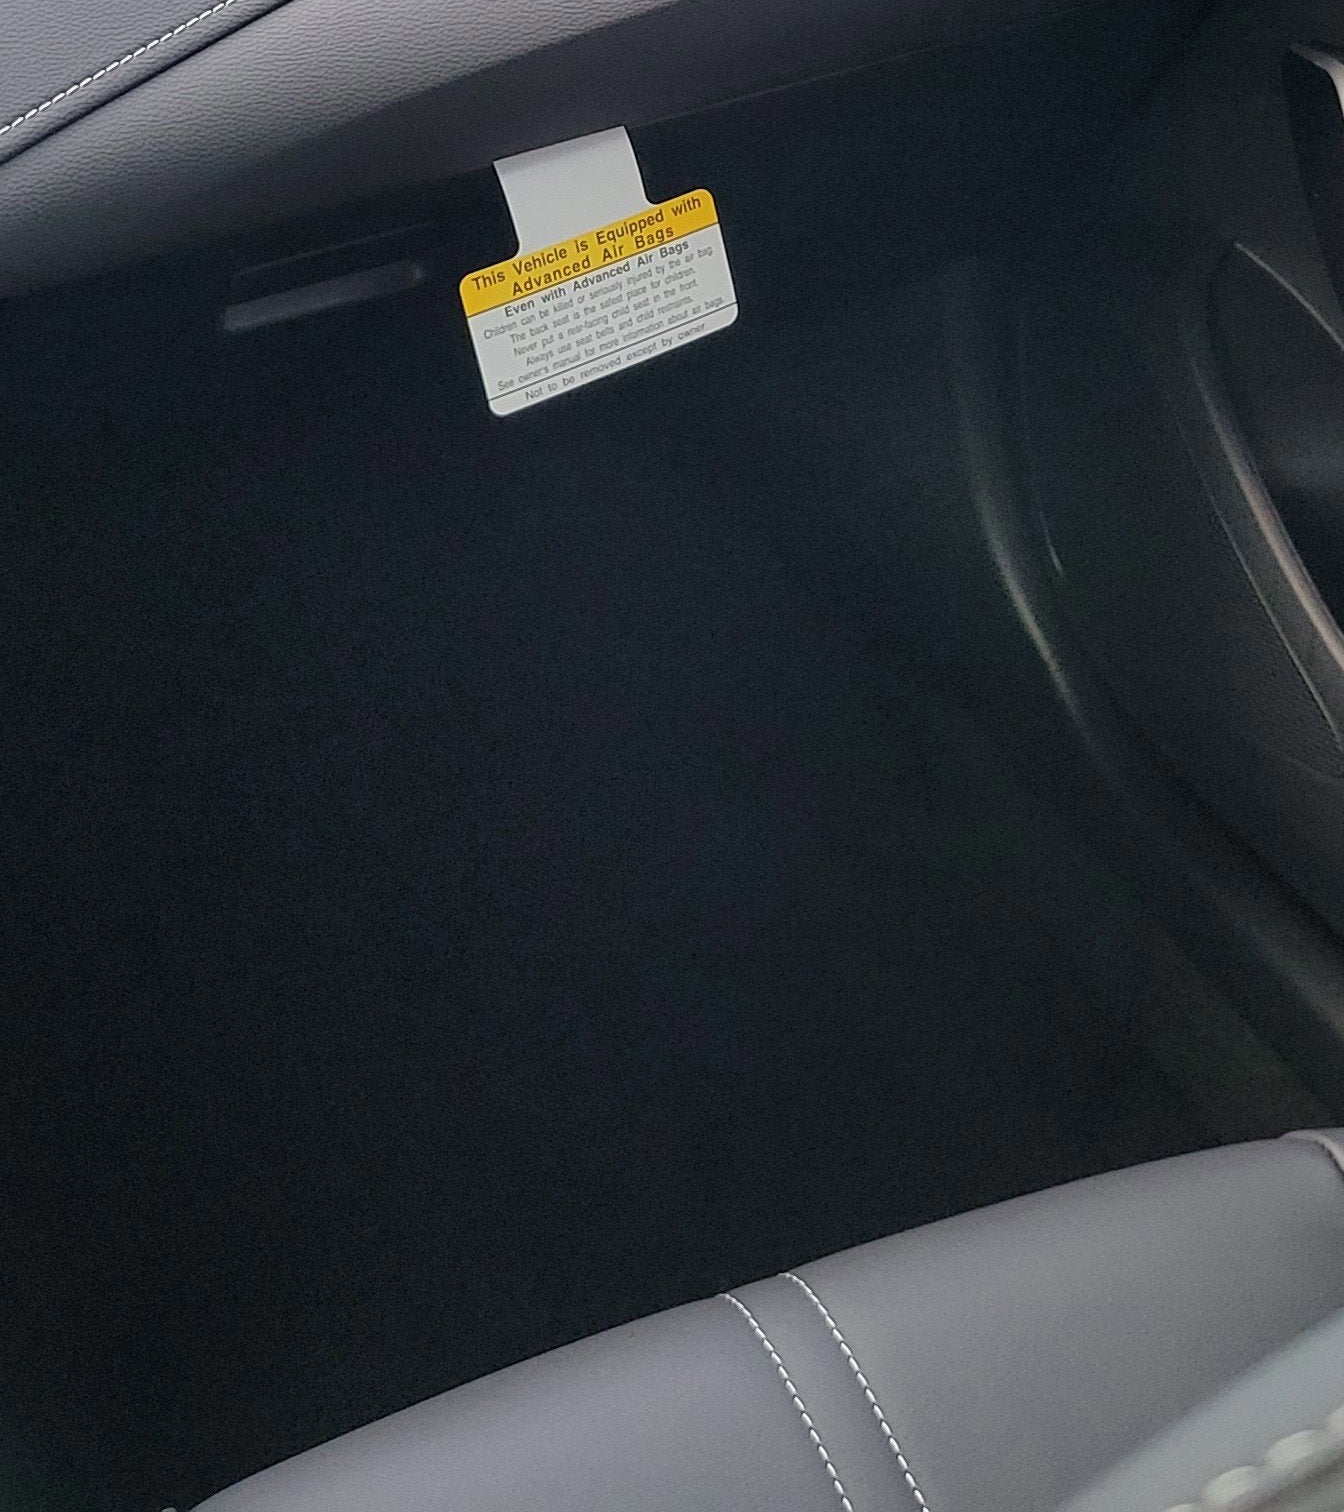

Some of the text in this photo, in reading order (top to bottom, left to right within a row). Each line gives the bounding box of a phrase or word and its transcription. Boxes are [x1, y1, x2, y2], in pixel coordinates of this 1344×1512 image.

[471, 195, 702, 291] This Vehicle is Equipped with
[512, 225, 674, 296] Advanced Air Bags
[483, 320, 518, 340] Children
[521, 314, 536, 326] can
[539, 308, 550, 319] be
[553, 297, 574, 313] killed
[577, 294, 586, 304] or
[589, 279, 624, 300] seriously
[626, 268, 653, 286] injured
[655, 265, 665, 275] by
[668, 258, 681, 270] the
[684, 252, 695, 264] air
[504, 240, 690, 318] Even with Advanced Air Bags
[510, 331, 526, 344] The
[529, 323, 549, 337] back
[552, 314, 570, 329] seat
[573, 310, 581, 320] is
[583, 304, 597, 316] the
[600, 293, 623, 310] safest
[627, 285, 647, 301] place
[650, 278, 661, 289] for
[498, 378, 515, 391] See
[518, 365, 549, 385] owner's
[552, 351, 582, 371] manual
[584, 345, 596, 357] for
[599, 338, 619, 353] more
[622, 320, 664, 343] information
[667, 309, 689, 325] about
[692, 303, 701, 316] air
[513, 341, 538, 357] Never
[541, 334, 555, 349] put
[567, 314, 609, 338] rear-facing
[611, 305, 630, 320] child
[633, 297, 650, 312] seat
[653, 293, 661, 303] in
[663, 287, 676, 300] the
[526, 350, 554, 367] Always
[558, 342, 572, 355] use
[576, 334, 593, 348] seat
[596, 325, 615, 340] belts
[618, 319, 633, 331] and
[636, 309, 654, 324] child
[525, 386, 544, 401] Not
[547, 382, 557, 392] to
[562, 375, 576, 387] be
[580, 355, 622, 380] removed
[626, 342, 658, 362] except
[661, 336, 673, 349] by
